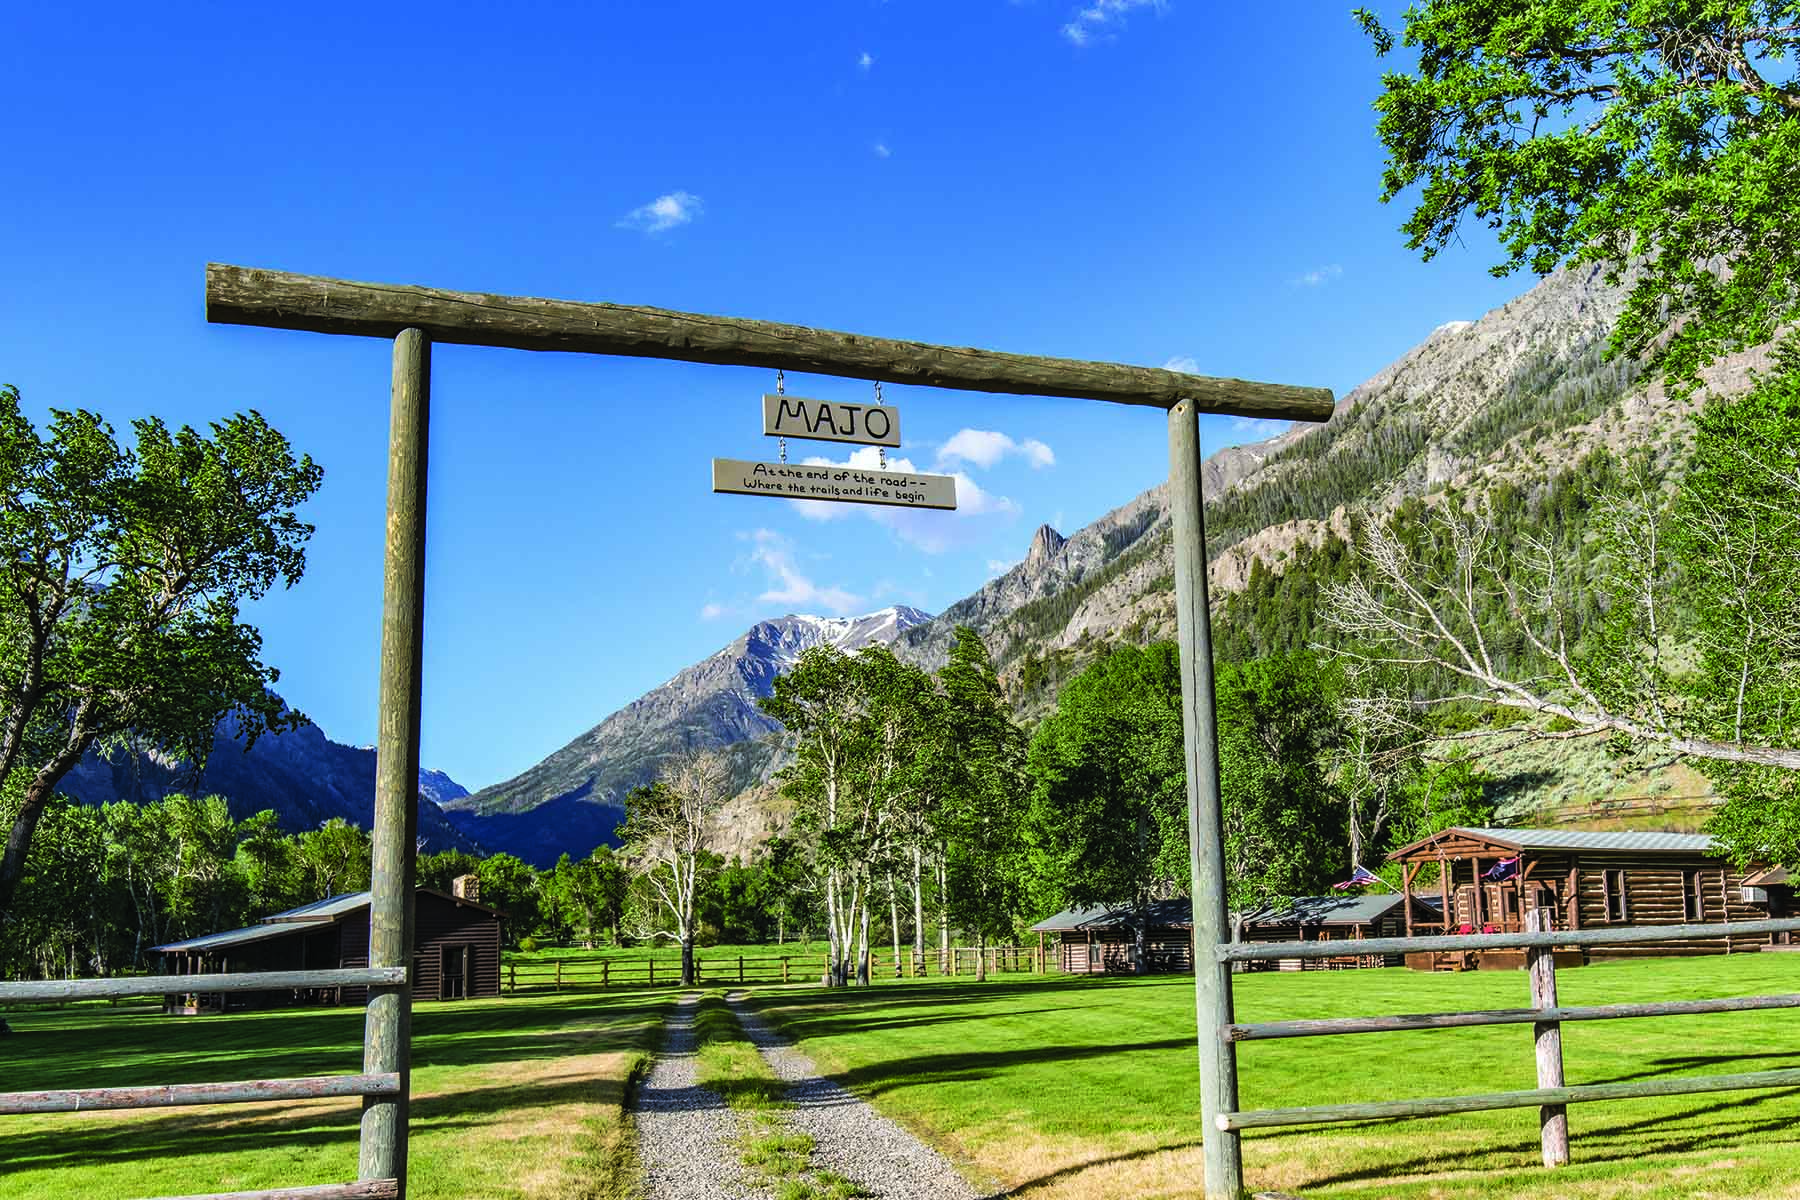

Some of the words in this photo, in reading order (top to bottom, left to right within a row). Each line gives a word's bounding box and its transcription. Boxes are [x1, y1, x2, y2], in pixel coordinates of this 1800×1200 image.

[775, 400, 890, 439] MAJO
[778, 468, 802, 478] the
[807, 470, 828, 480] end
[834, 472, 850, 481] of
[853, 474, 874, 484] the
[743, 479, 783, 490] Where
[788, 482, 805, 492] the
[866, 487, 888, 497] life
[896, 491, 925, 503] begin
